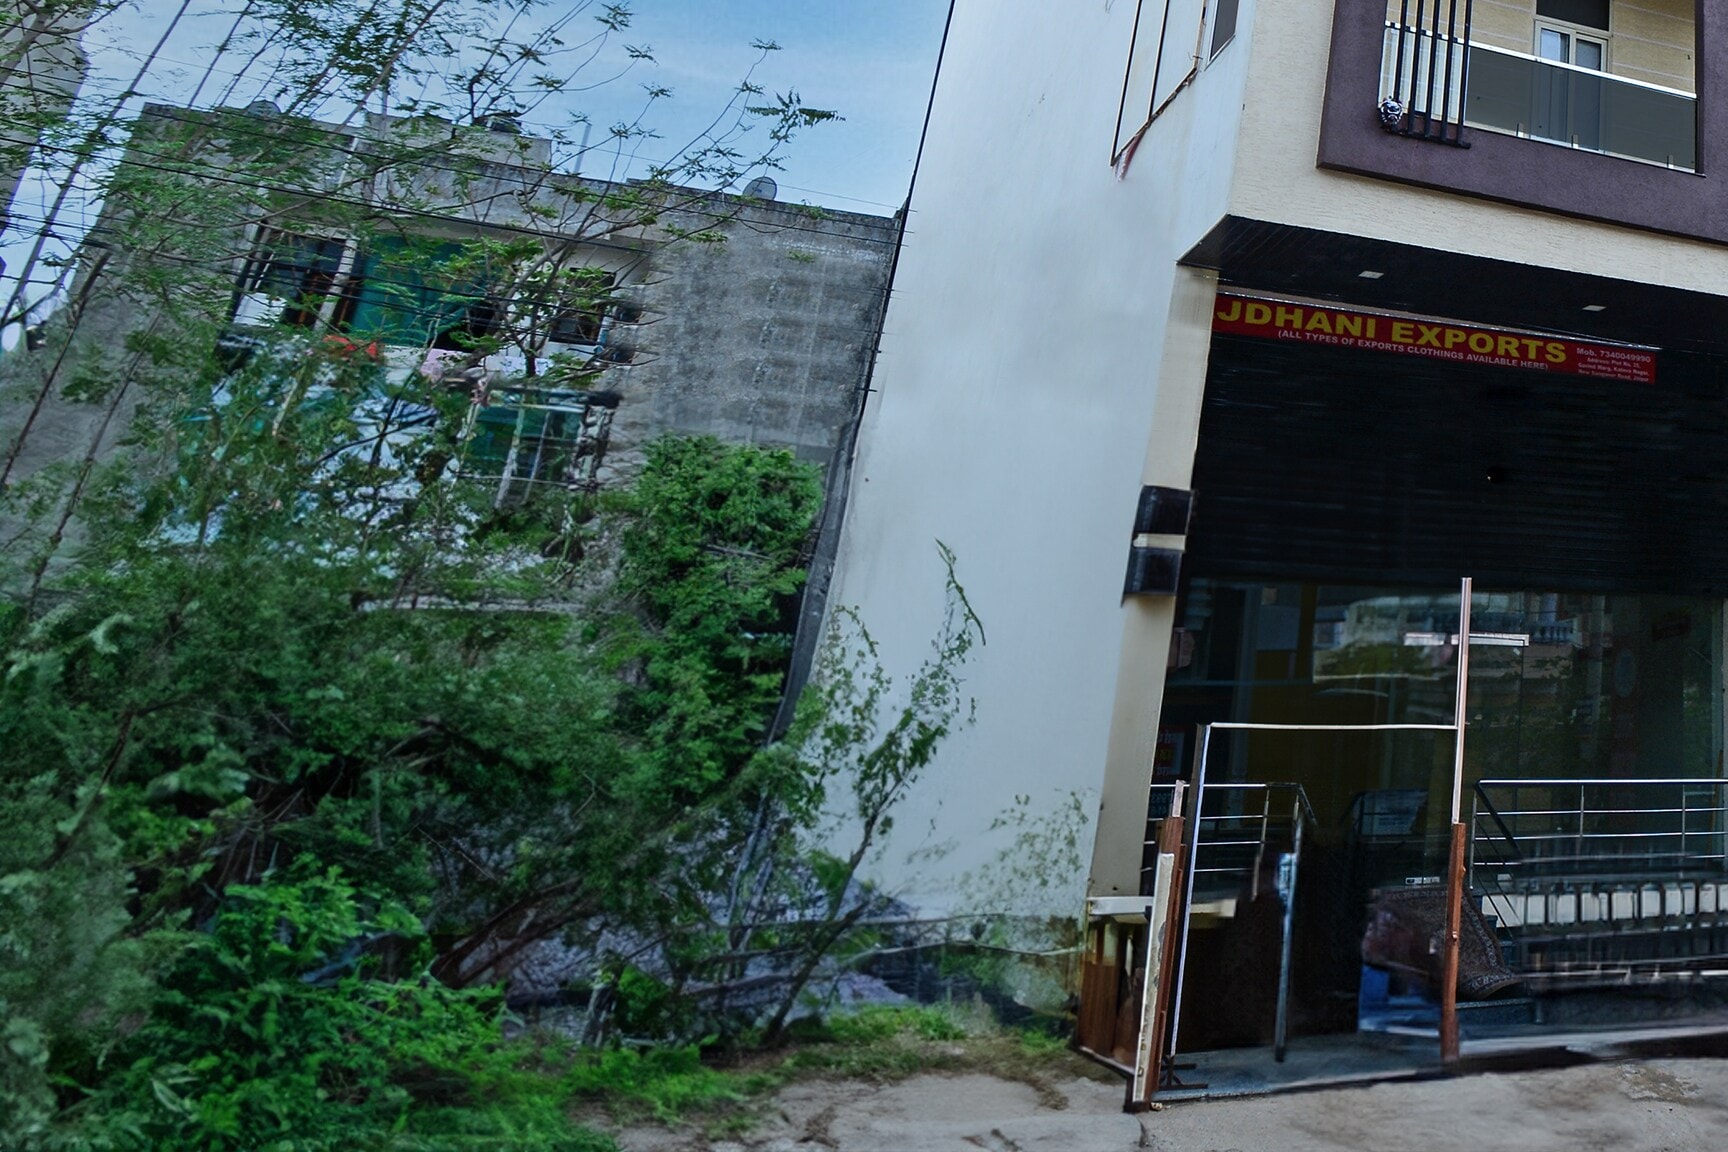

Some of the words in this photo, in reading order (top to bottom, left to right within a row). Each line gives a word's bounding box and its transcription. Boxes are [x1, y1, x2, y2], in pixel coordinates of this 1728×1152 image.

[1215, 301, 1376, 338] JDHANI
[1391, 321, 1567, 363] EXPORTS
[1278, 330, 1302, 339] (ALL
[1305, 332, 1338, 344] TYPES
[1358, 339, 1404, 353] EXPORTS
[1407, 346, 1463, 360] CLOTHINGS
[1466, 354, 1517, 367] AVAILABLE
